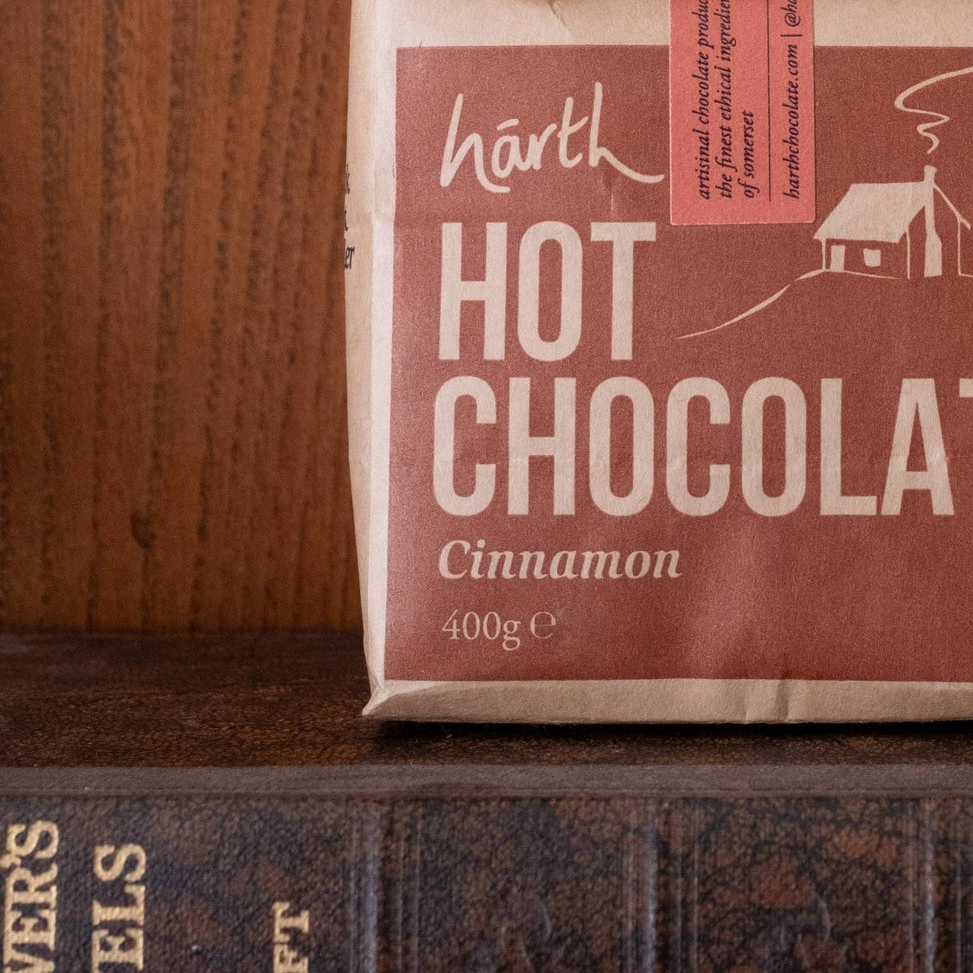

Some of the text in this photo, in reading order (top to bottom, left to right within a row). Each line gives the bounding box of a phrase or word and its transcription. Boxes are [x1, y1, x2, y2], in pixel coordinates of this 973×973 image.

[692, 52, 710, 125] chocolate
[714, 65, 732, 121] ethical
[715, 126, 738, 173] finest
[781, 44, 800, 200] harthchocolate.com
[692, 128, 710, 200] artisinal
[715, 173, 732, 199] the
[738, 110, 760, 199] of somerset
[438, 220, 657, 362] HOT
[437, 538, 683, 580] Cinnamon
[441, 609, 522, 651] 400g
